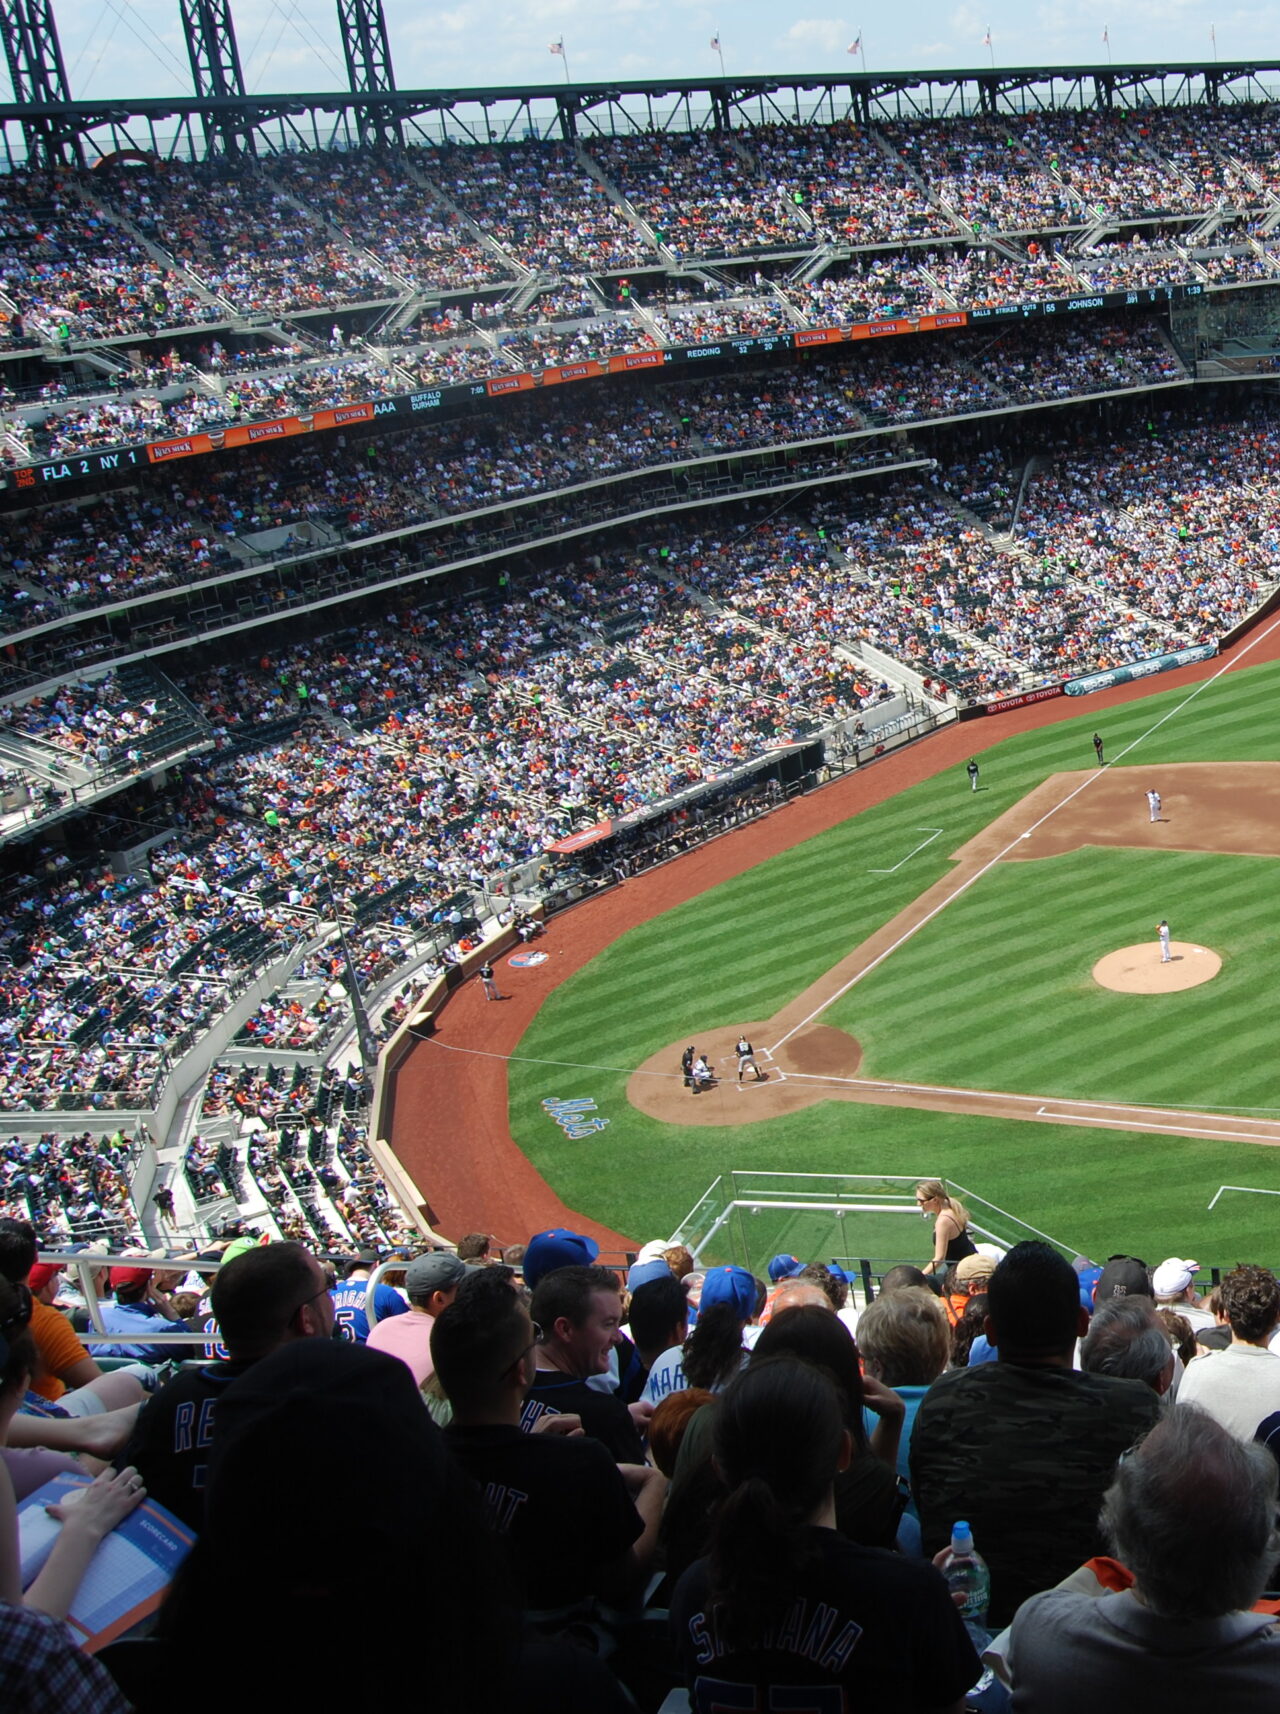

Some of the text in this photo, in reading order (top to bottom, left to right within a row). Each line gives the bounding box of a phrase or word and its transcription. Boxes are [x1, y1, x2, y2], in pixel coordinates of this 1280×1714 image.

[1187, 286, 1201, 295] 1:39
[973, 303, 1036, 317] BALLS STRIKES OUTS
[1046, 298, 1103, 312] 55 JOHNSON
[687, 347, 720, 358] REDDING
[411, 391, 442, 403] BUFFALO
[373, 401, 397, 415] AAA
[412, 399, 440, 411] DURHAM
[42, 451, 137, 481] FLA 2 NY 1
[14, 468, 34, 480] TOP
[16, 477, 36, 488] 2ND
[998, 686, 1061, 710] TOYOTA TOYOTA
[541, 1097, 610, 1139] Mets
[332, 1290, 367, 1311] RIGH
[139, 1518, 178, 1552] SCORECARD
[689, 1596, 864, 1672] SANA
